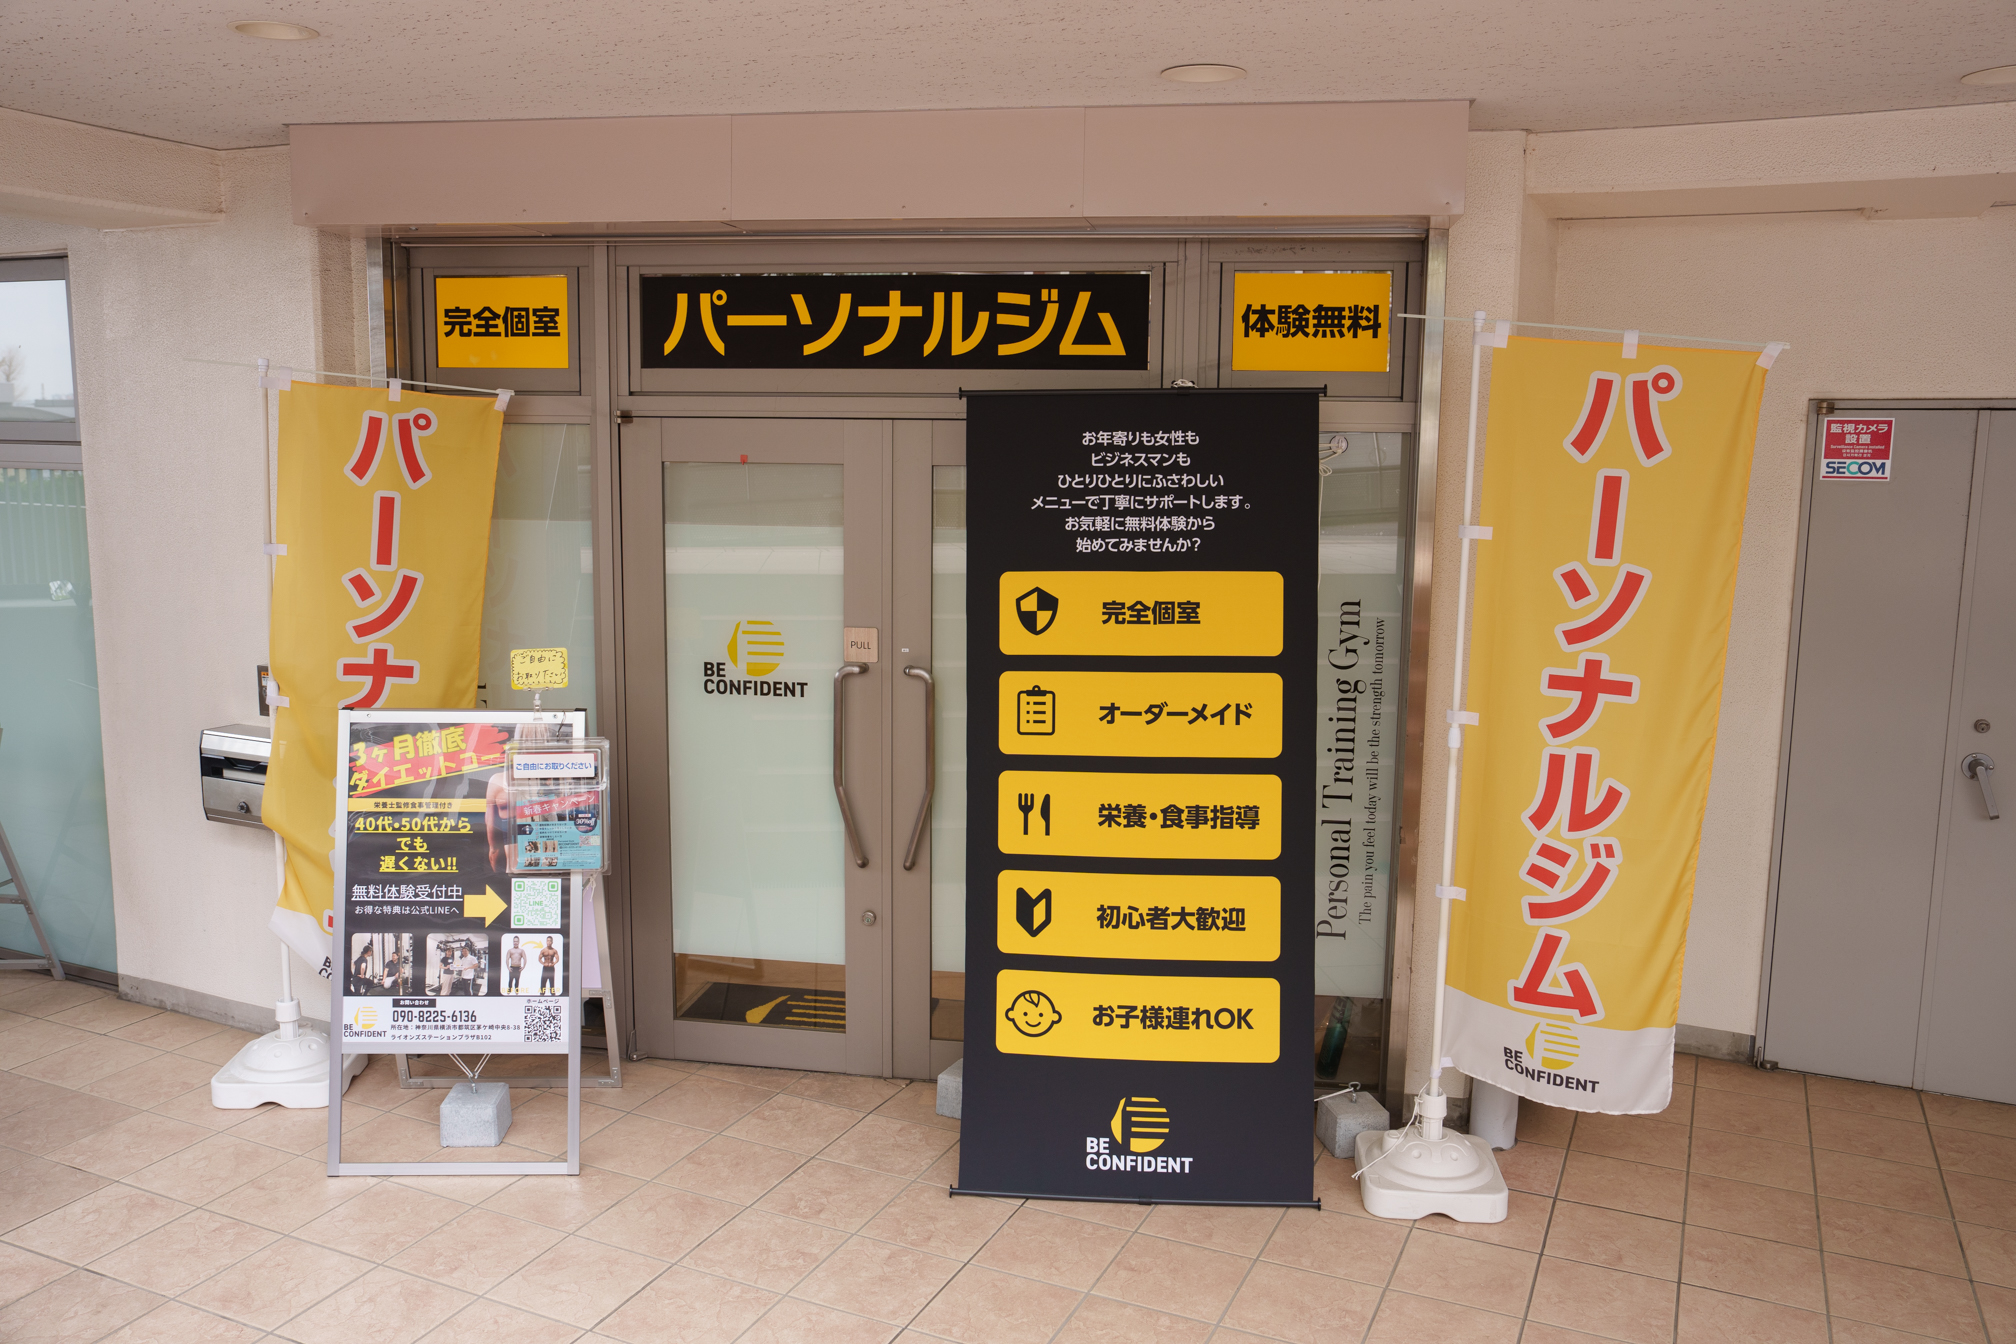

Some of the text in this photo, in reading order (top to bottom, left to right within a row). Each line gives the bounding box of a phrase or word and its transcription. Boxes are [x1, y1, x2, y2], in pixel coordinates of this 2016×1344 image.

[444, 306, 560, 338] 完全個室
[664, 289, 1126, 357] パーソナルジム
[1241, 304, 1381, 338] 体験無料
[1830, 423, 1888, 433] 監視カメラ
[1082, 430, 1199, 446] お年寄りも女性も
[1845, 434, 1871, 443] 設置
[1091, 452, 1191, 467] ビジネスマンも
[1825, 461, 1886, 475] SECOM
[1058, 474, 1224, 488] ひとりひとりにふさわしい
[1031, 494, 1251, 510] メニューで丁寧にサポートします。
[1065, 516, 1215, 532] お気軽に無料体験から
[1101, 600, 1201, 625] 完全個室
[850, 640, 872, 650] PULL
[519, 654, 557, 665] ご自由に
[703, 661, 727, 678] BE
[703, 679, 808, 697] CONFIDENT
[1508, 366, 1682, 1023] パーソナルジム
[1099, 701, 1252, 725] オーダーメイド
[515, 762, 592, 771] ご自由にお取りください
[1316, 599, 1370, 940] Personal Training Gym
[1358, 617, 1386, 924] The pain you feel today will be the strength tomorrow
[374, 801, 453, 809] 栄養士監修食事管理付き
[523, 794, 595, 816] 新春キャンペーン
[1098, 803, 1260, 829] 栄養・食事指導
[396, 836, 428, 851] でも
[352, 884, 463, 900] 無料体験受付中
[354, 905, 460, 915] お得な特典は公式LINEへ
[1096, 904, 1246, 932] 初心者大歓迎
[392, 1010, 477, 1022] 090-8225-6136
[1092, 1004, 1255, 1030] お子様連れOK
[343, 1030, 387, 1038] CONFIDENT
[1503, 1046, 1524, 1064] BE
[1504, 1058, 1600, 1093] CONFIDENT
[1086, 1137, 1110, 1153] BE
[1086, 1154, 1193, 1173] CONFIDENT
